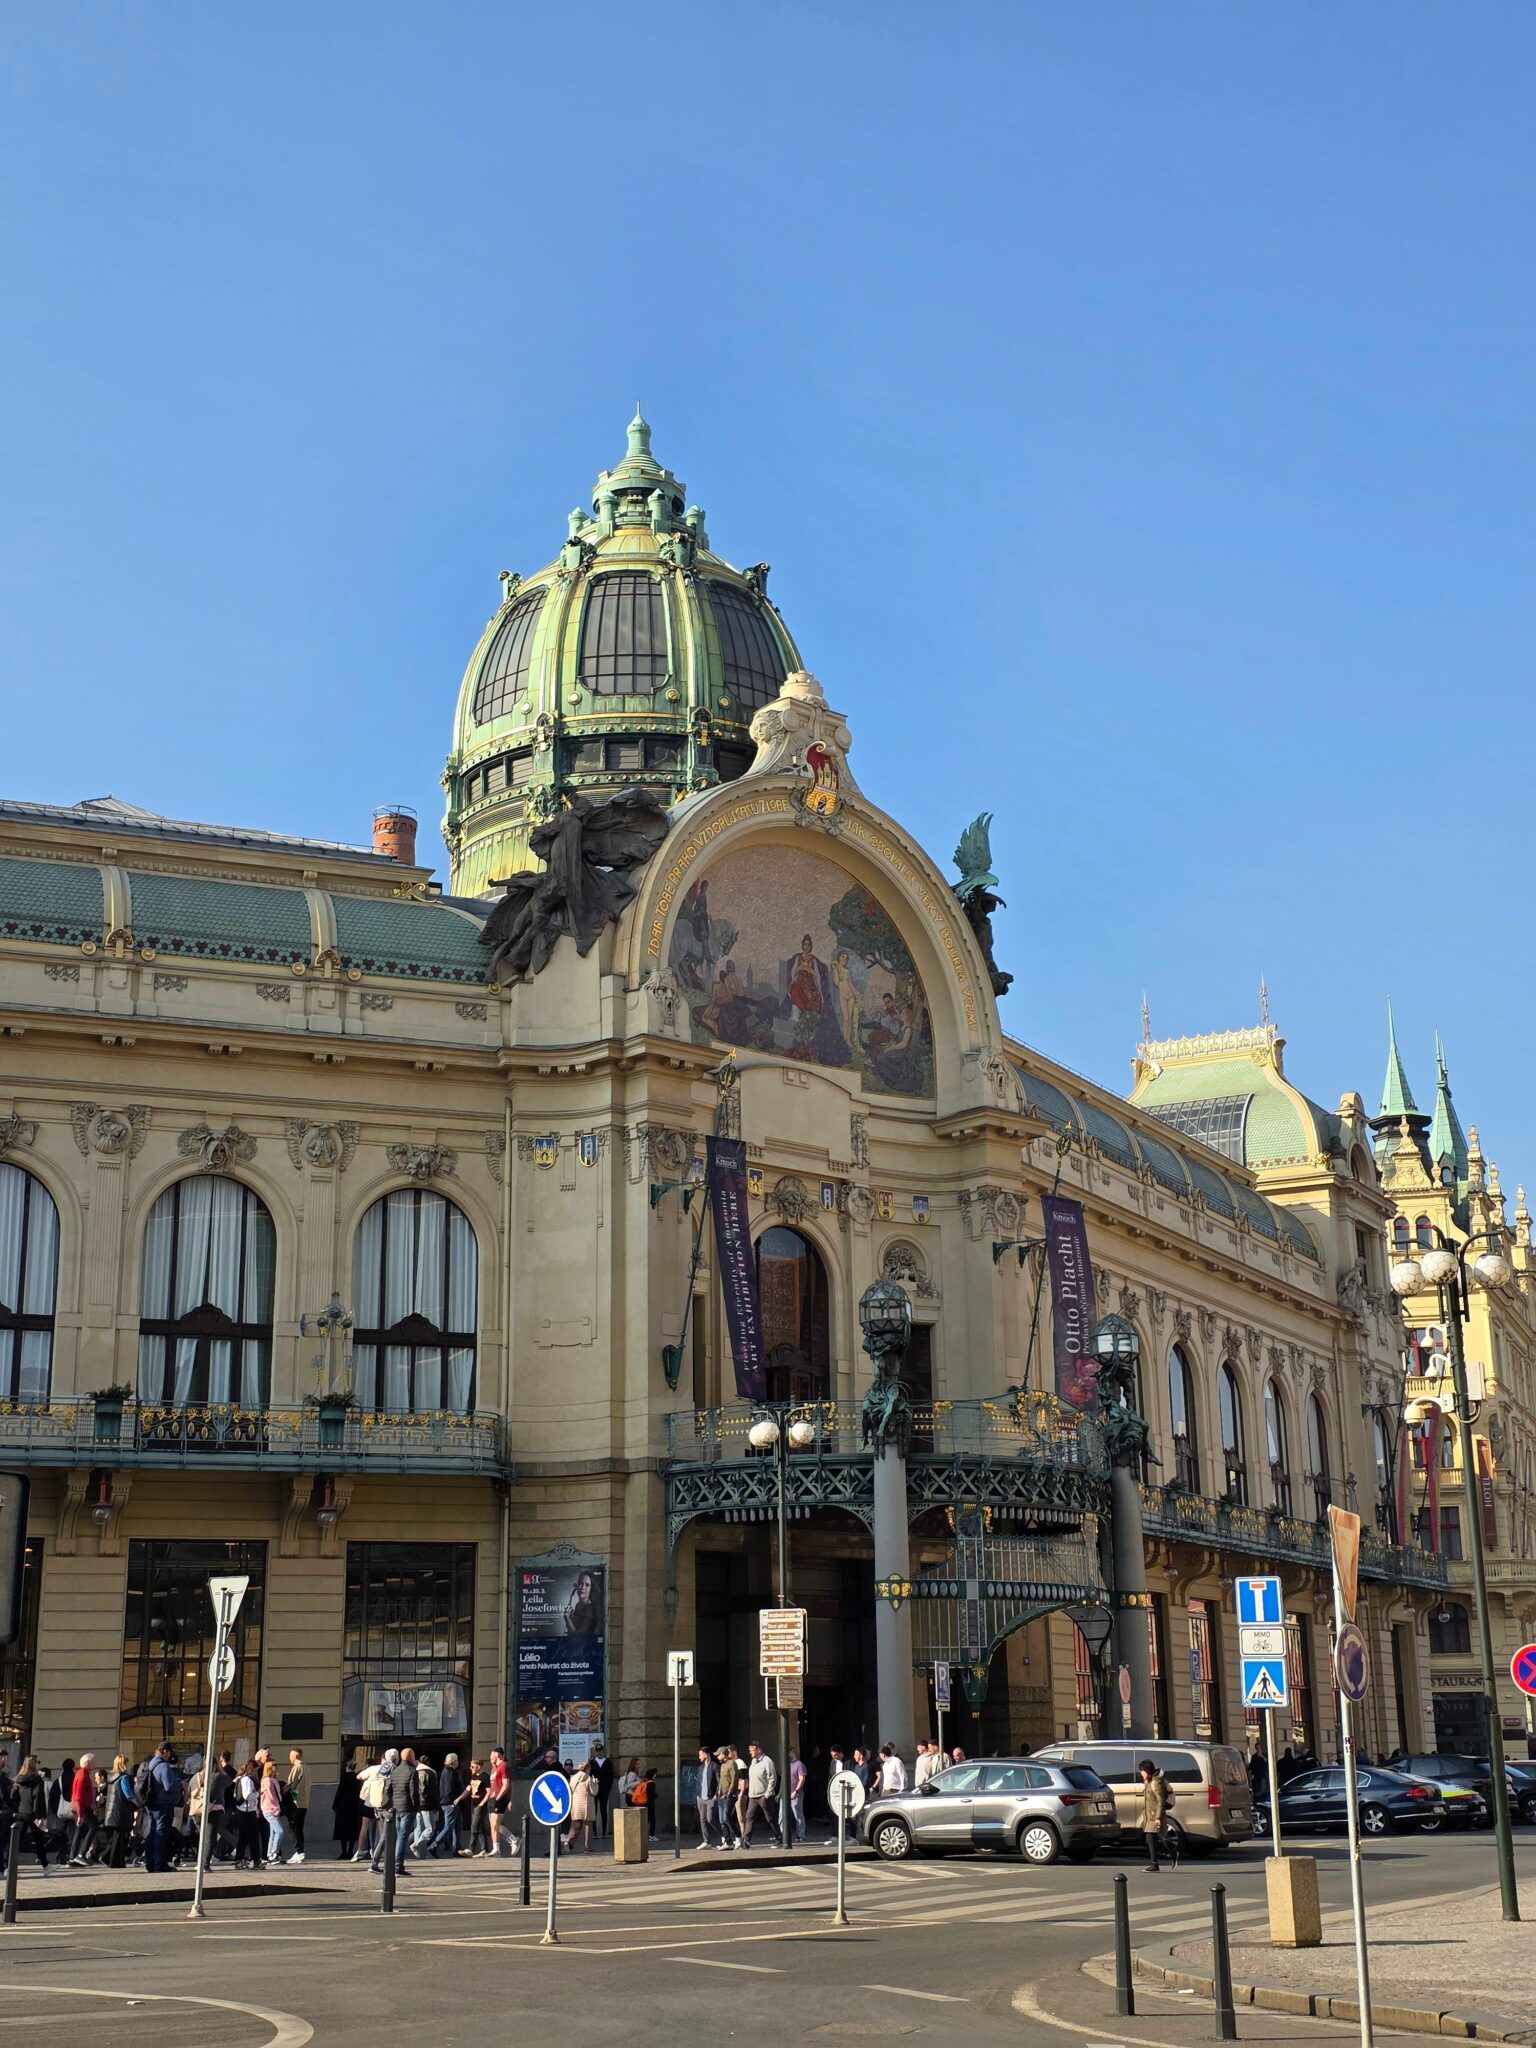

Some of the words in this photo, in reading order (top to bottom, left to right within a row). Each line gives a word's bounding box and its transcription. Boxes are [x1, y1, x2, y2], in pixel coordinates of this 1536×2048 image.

[847, 819, 866, 839] JAK
[648, 919, 664, 959] ZDAR
[721, 1190, 732, 1247] Amazonia
[729, 1191, 741, 1232] HERE
[727, 1250, 735, 1263] of
[1058, 1234, 1078, 1299] Placht
[731, 1269, 744, 1315] Eternity
[734, 1240, 756, 1335] EXHIBITION
[740, 1321, 750, 1370] Fleeting
[1065, 1308, 1081, 1354] Otto
[749, 1341, 758, 1370] ART
[1482, 1477, 1493, 1507] HOTEL
[522, 1595, 544, 1604] Leila
[538, 1662, 560, 1670] Návrat
[570, 1661, 590, 1669] života
[1431, 1677, 1482, 1688] STAURAN
